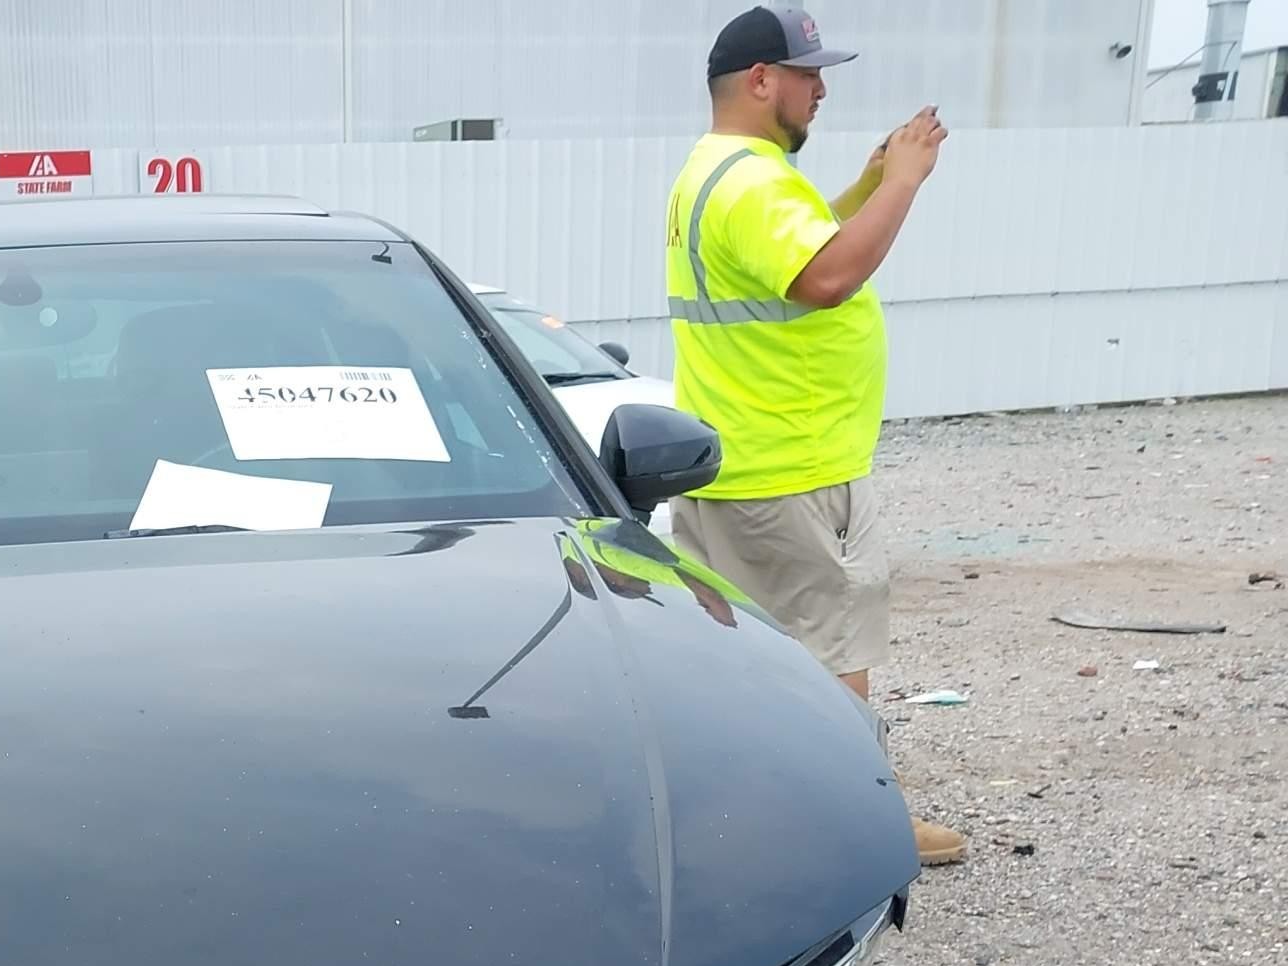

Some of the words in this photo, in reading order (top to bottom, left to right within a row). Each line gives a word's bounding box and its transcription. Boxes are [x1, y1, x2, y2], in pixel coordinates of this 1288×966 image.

[147, 158, 202, 193] 20
[17, 182, 44, 194] STATE
[46, 181, 72, 193] FARM
[238, 387, 398, 403] 45047620
